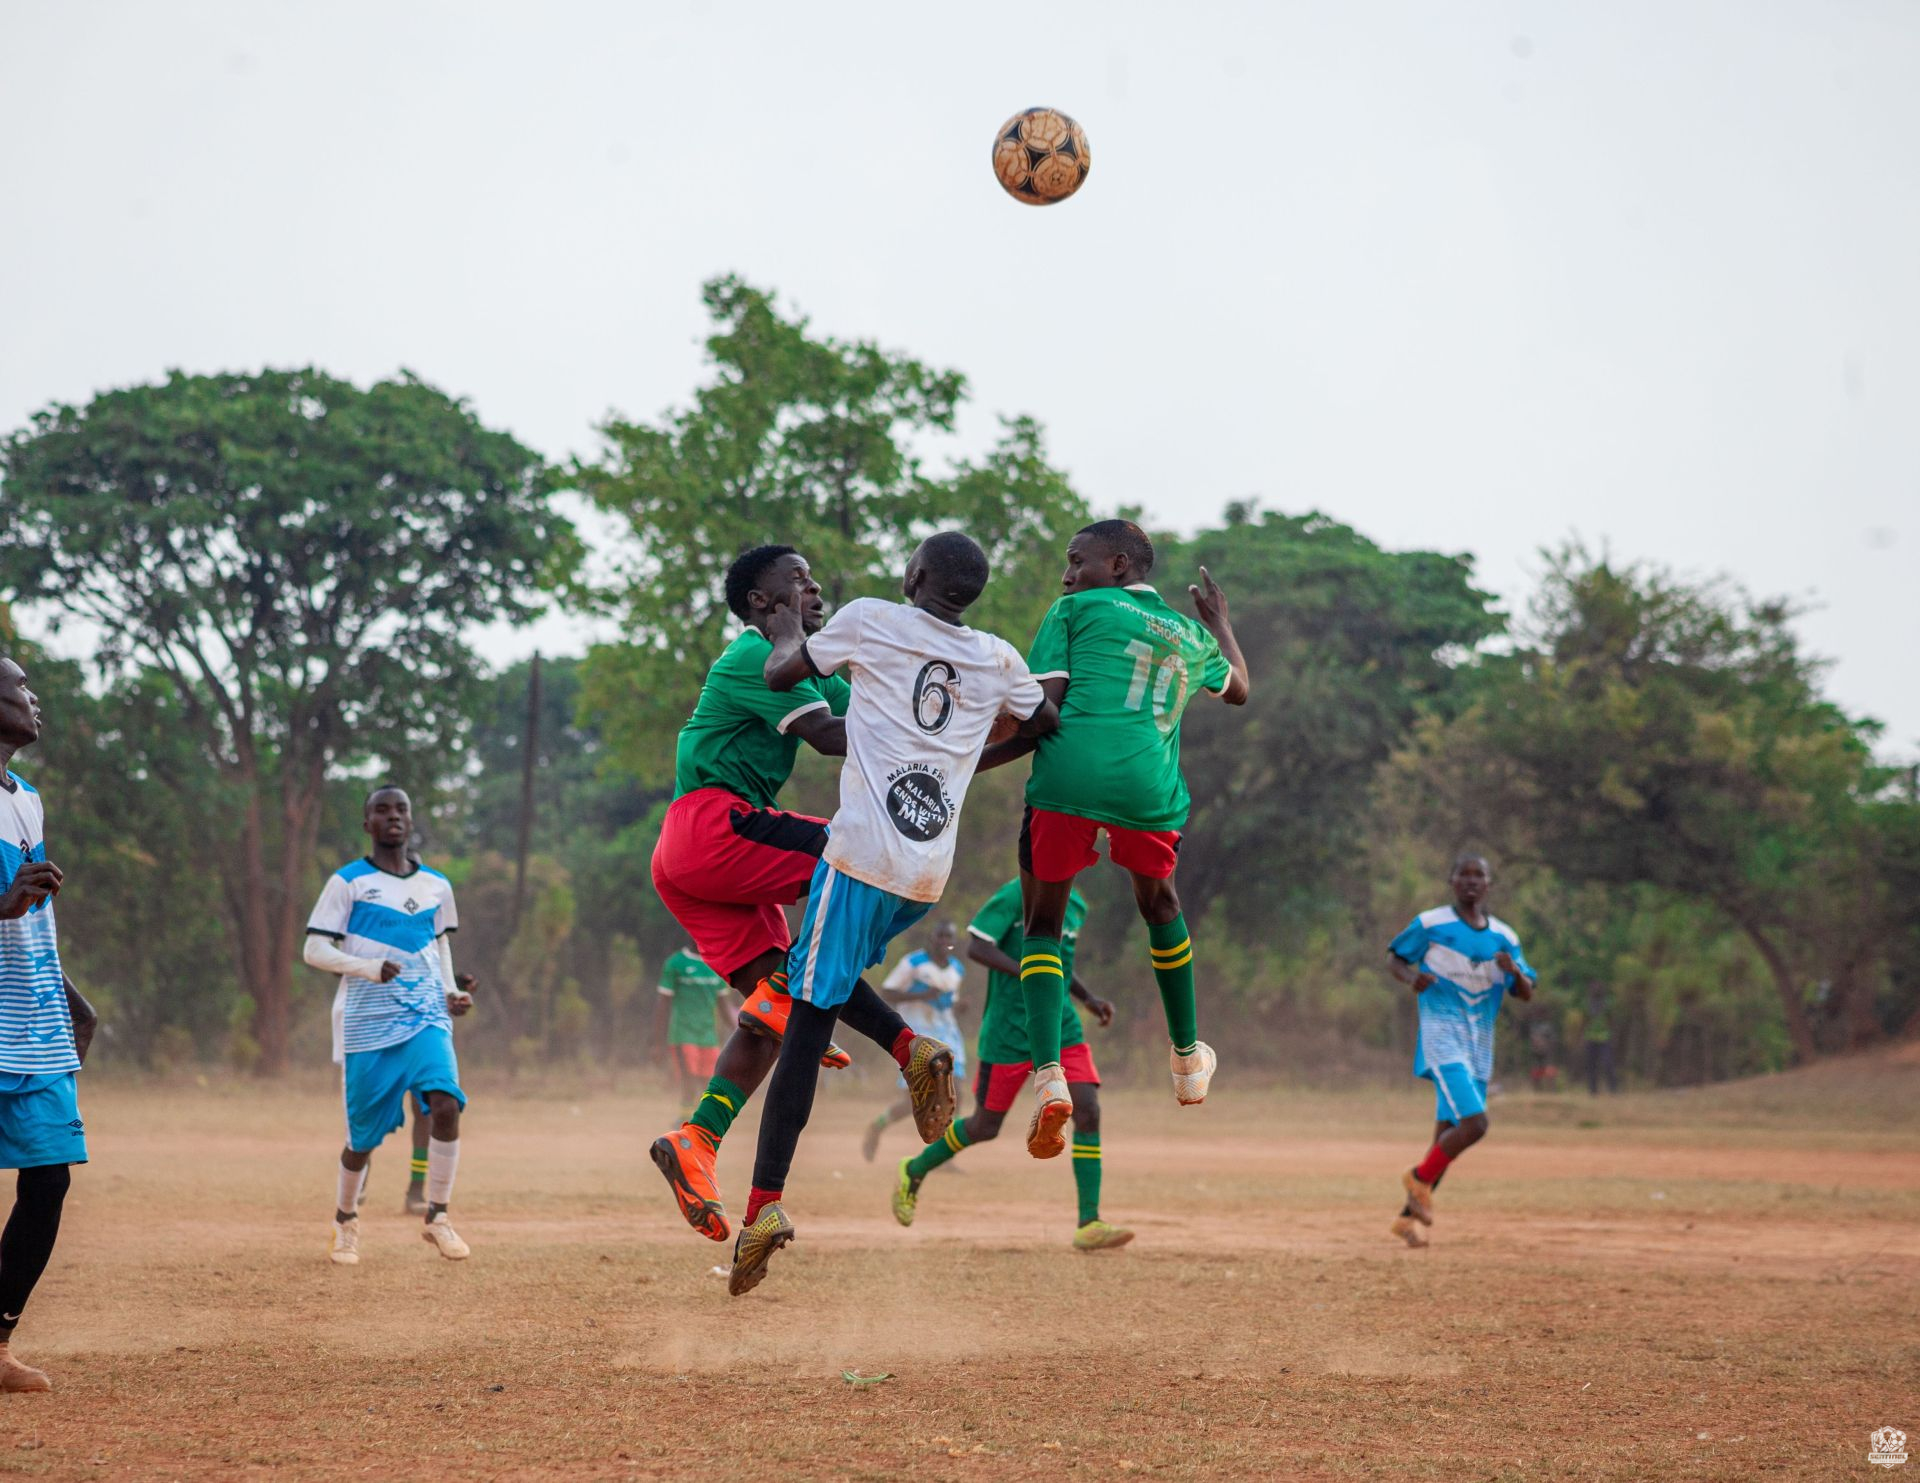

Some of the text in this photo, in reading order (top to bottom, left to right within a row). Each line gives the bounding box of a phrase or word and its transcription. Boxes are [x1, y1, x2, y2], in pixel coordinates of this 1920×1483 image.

[912, 660, 962, 736] 6
[1123, 638, 1189, 733] 10
[886, 763, 929, 783] MALARIA
[893, 785, 945, 826] ENDS WITH
[904, 779, 942, 813] MALARIA
[897, 802, 930, 836] ME.
